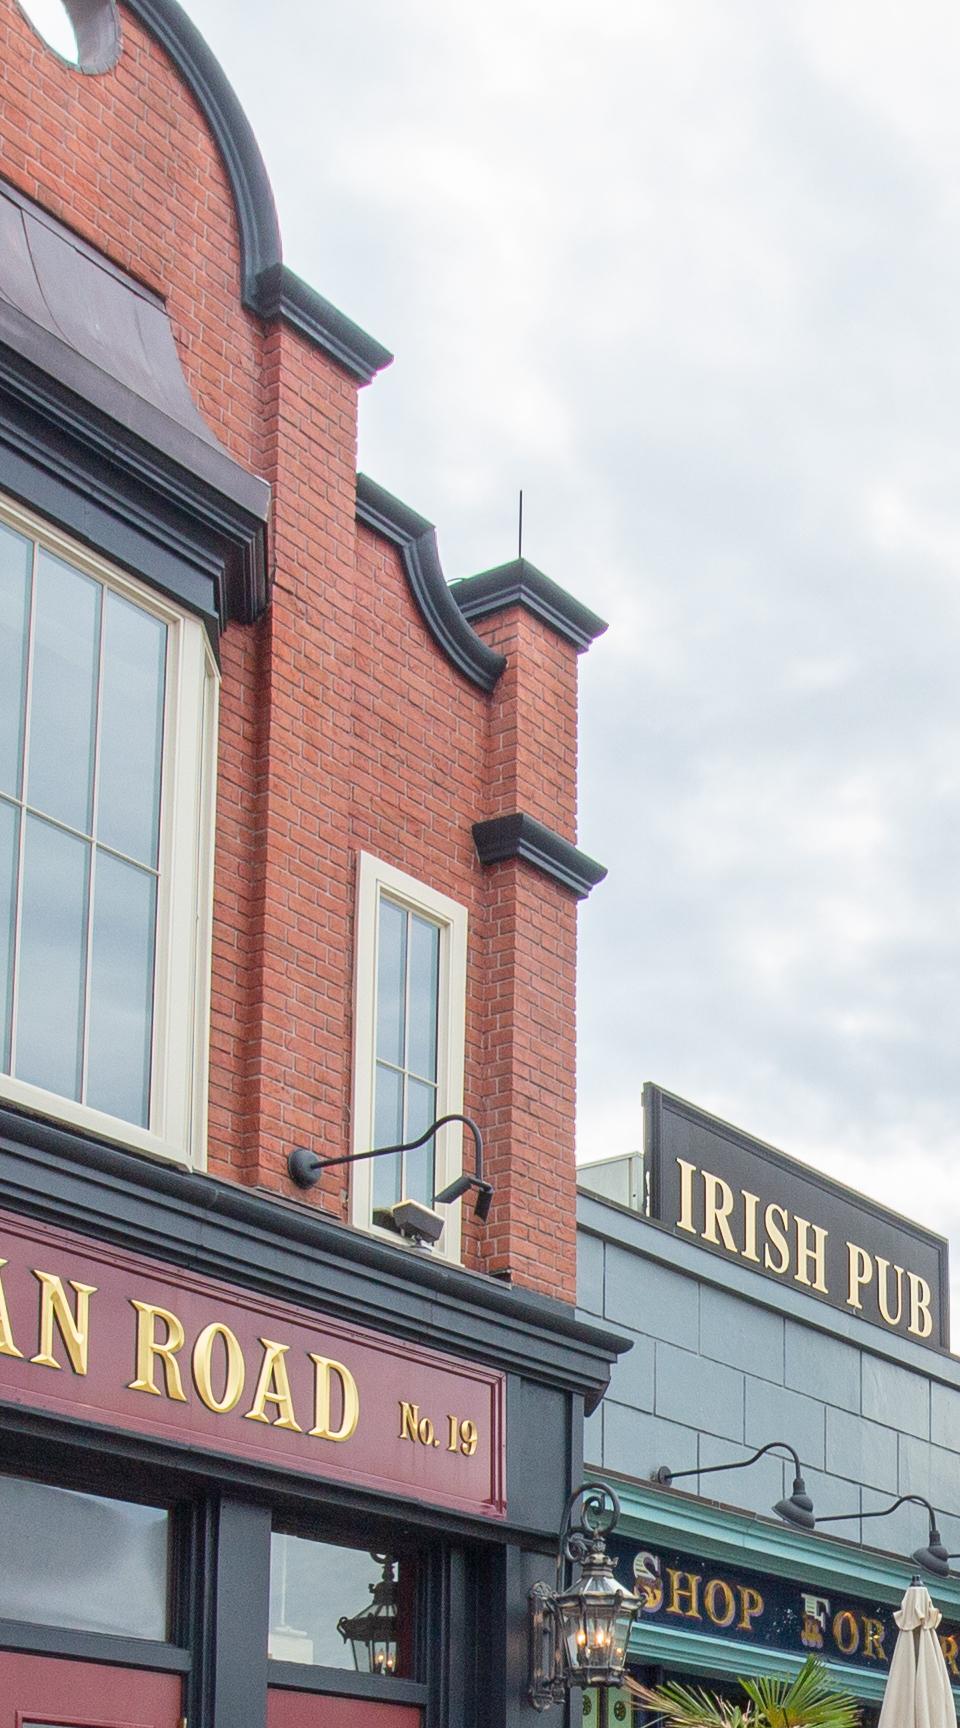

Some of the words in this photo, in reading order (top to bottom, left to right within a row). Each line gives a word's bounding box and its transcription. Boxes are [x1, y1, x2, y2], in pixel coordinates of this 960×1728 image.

[675, 1157, 829, 1294] IRISH
[845, 1241, 933, 1338] PUB
[128, 1299, 360, 1442] ROAD
[398, 1401, 441, 1448] No.
[446, 1414, 478, 1457] 19
[632, 1551, 765, 1633] SHOP
[801, 1592, 889, 1663] FOR
